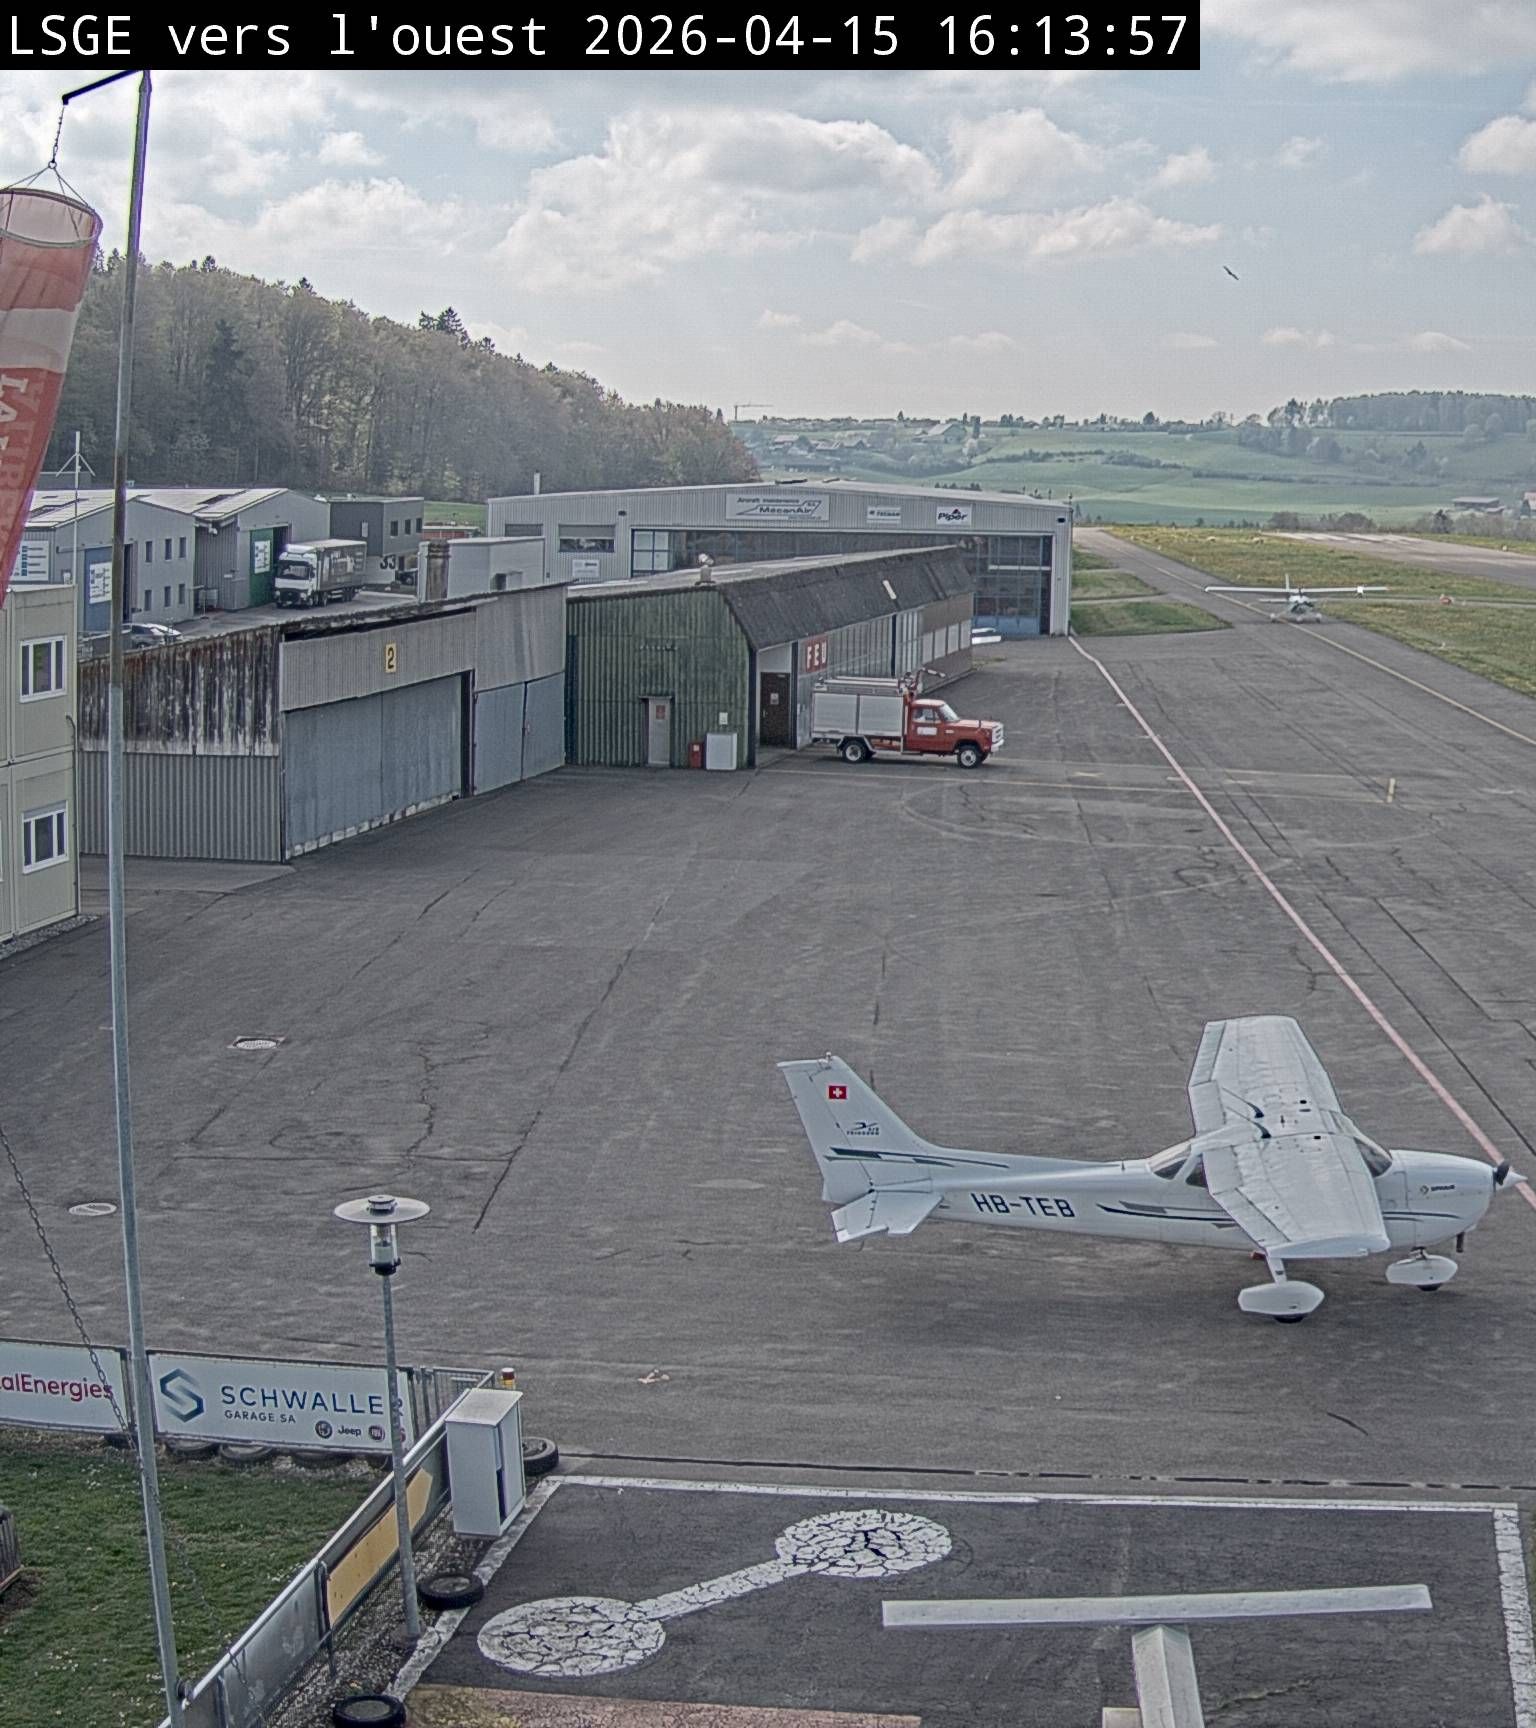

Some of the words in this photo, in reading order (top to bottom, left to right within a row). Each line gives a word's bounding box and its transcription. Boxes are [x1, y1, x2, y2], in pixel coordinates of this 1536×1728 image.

[938, 511, 968, 521] Piper
[387, 647, 395, 669] 2
[806, 640, 827, 670] FEU
[971, 1193, 1076, 1218] HB-TEB
[0, 1373, 113, 1402] alEnergies
[224, 1409, 275, 1423] GARAGE
[280, 1413, 297, 1424] SA
[338, 1425, 362, 1437] Jeep
